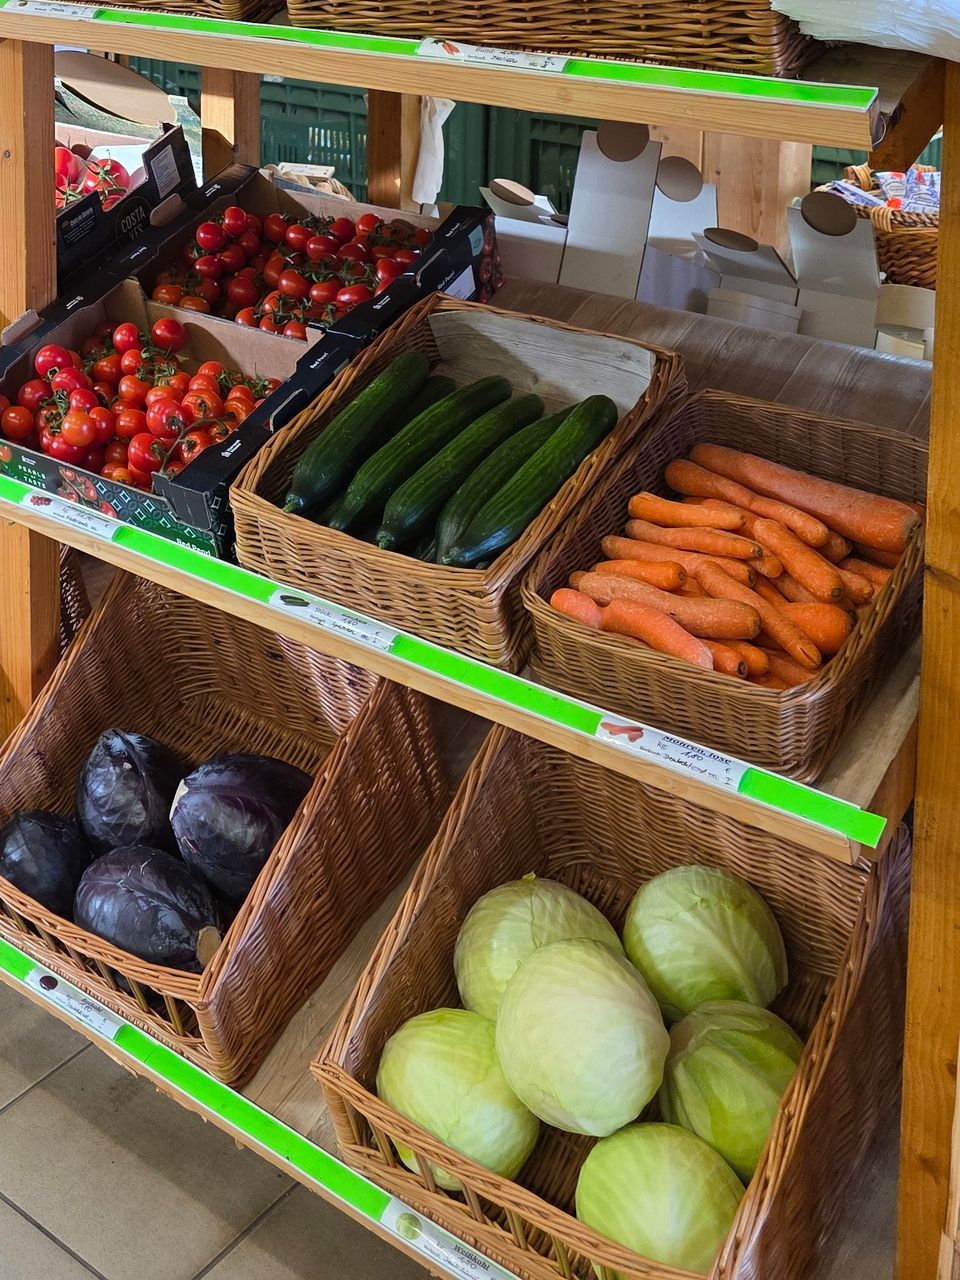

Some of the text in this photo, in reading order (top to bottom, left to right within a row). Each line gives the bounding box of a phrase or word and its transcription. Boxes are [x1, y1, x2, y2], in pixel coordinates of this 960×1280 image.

[121, 206, 146, 233] COSTA
[18, 464, 47, 480] PEARLS
[24, 475, 47, 489] TASTE
[453, 1244, 491, 1271] Weißkohl
